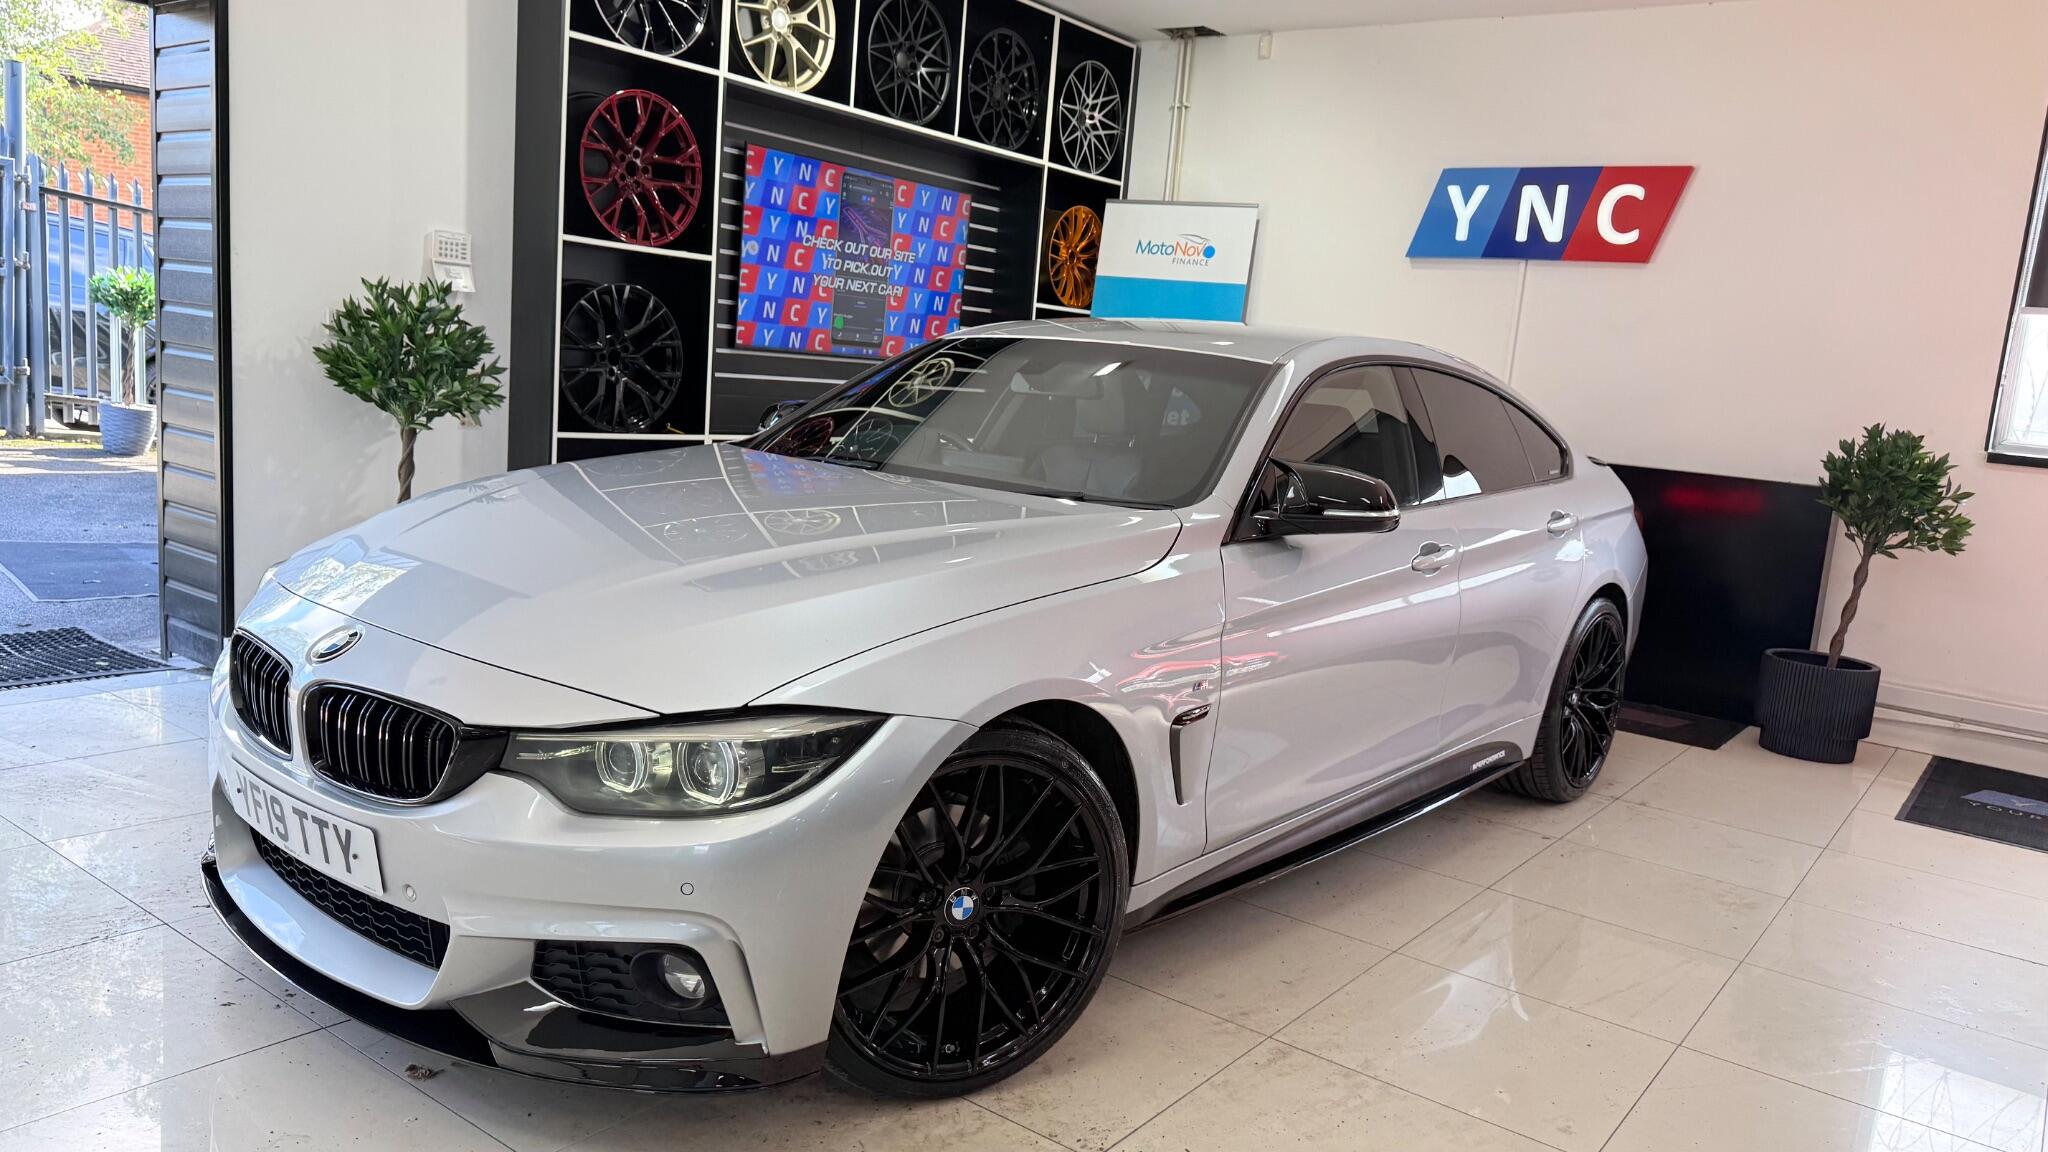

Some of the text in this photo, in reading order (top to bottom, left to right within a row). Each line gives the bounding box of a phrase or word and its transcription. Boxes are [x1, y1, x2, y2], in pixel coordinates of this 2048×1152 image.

[1446, 183, 1646, 245] YNC
[802, 235, 916, 263] CHECK OUT OUR SITE
[1136, 239, 1216, 259] MotoNovo
[827, 257, 893, 278] TO PICK OUT
[1171, 257, 1210, 267] FINANCE
[813, 273, 904, 298] YOUR NEXT CAR!
[235, 770, 353, 875] YF19 TTY
